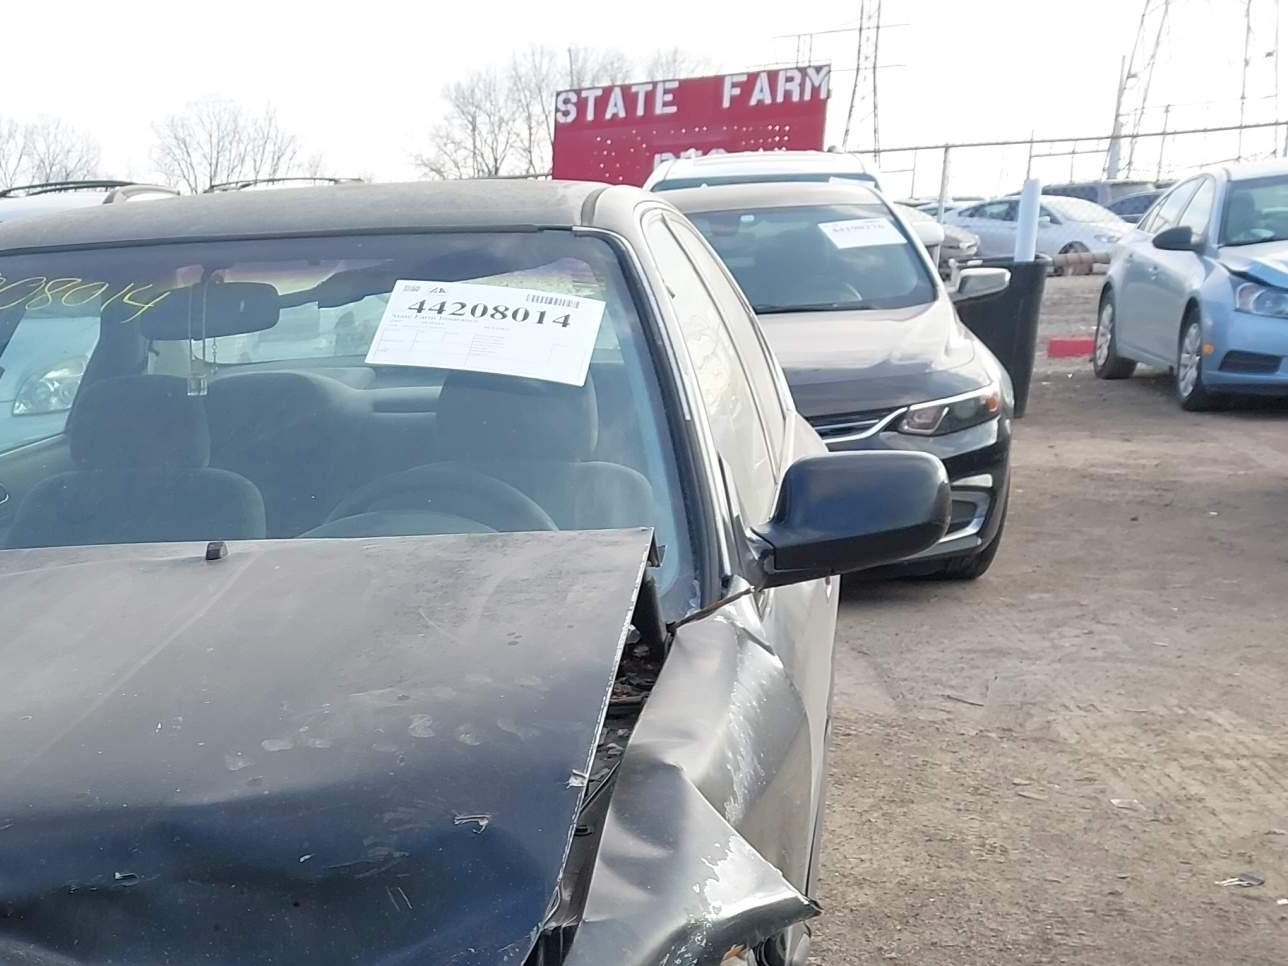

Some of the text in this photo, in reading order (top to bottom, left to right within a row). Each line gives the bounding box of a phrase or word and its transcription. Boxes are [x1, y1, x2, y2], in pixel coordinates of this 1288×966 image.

[556, 66, 831, 123] STATE FARM
[408, 299, 571, 328] 44208014
